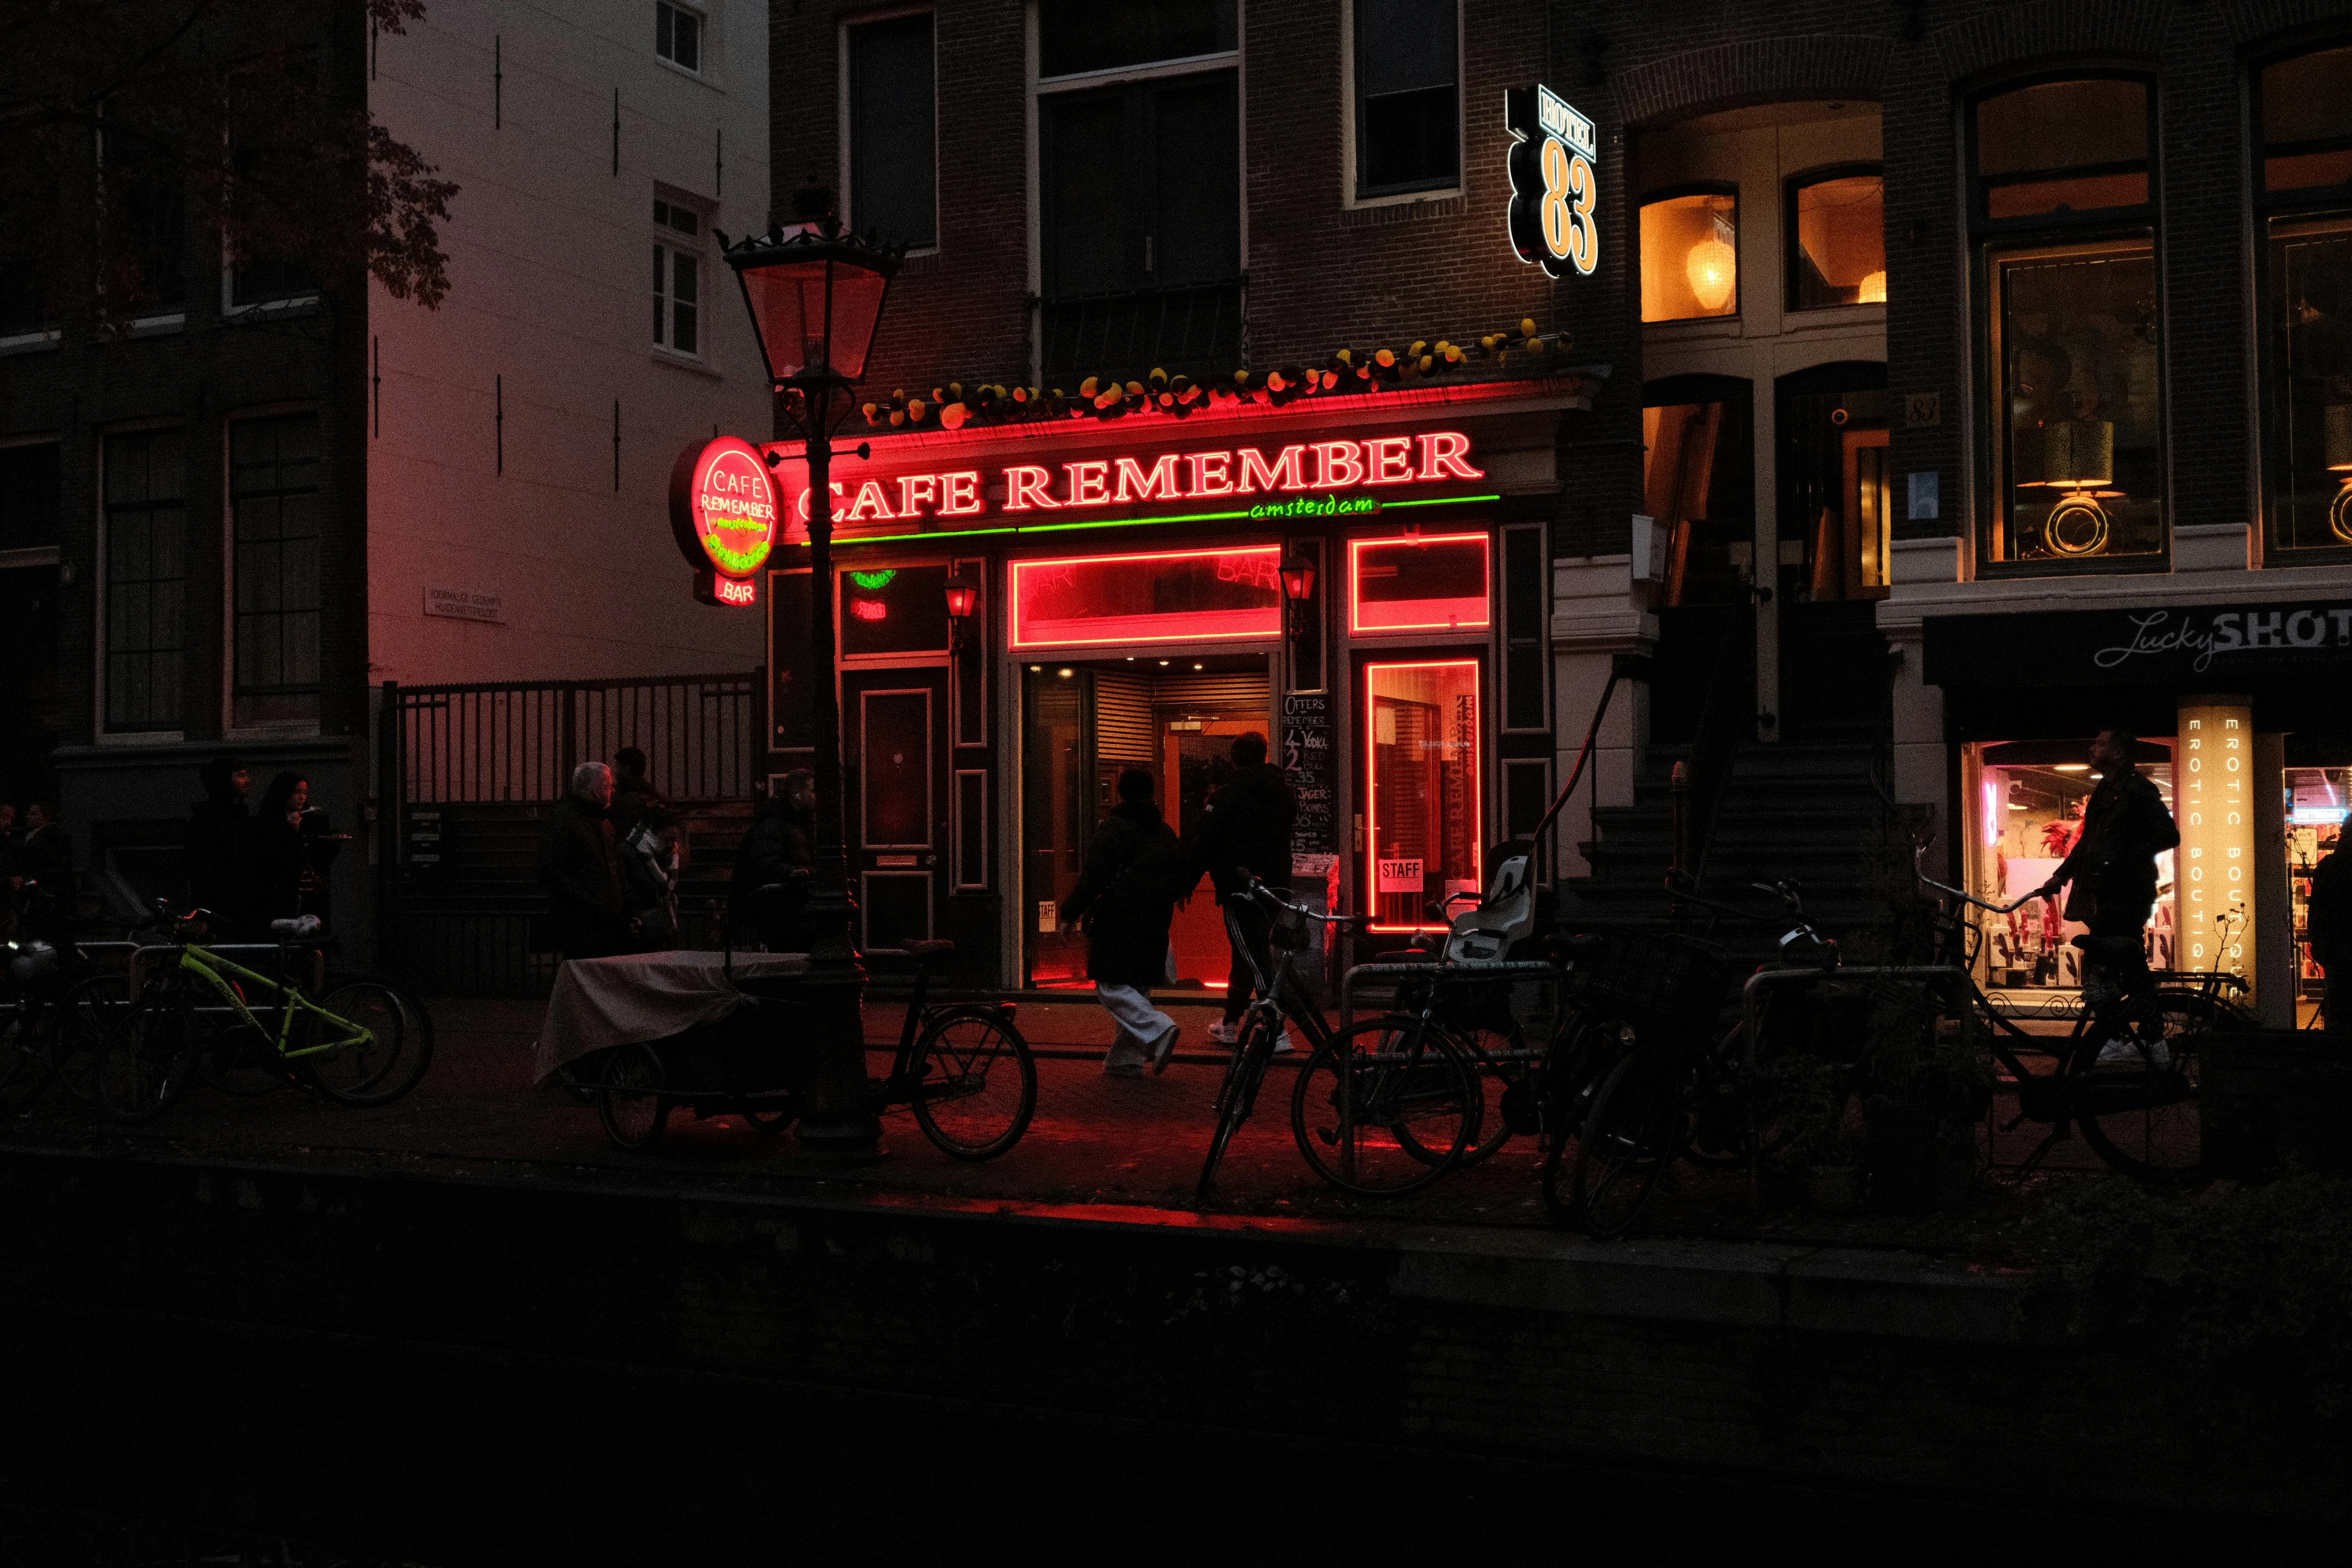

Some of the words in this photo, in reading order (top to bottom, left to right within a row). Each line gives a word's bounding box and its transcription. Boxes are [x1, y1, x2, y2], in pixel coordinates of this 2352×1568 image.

[1542, 91, 1593, 152] HOTEL
[1541, 136, 1598, 275] 83
[714, 470, 762, 498] CAFE
[1003, 432, 1485, 509] REMEMBER
[702, 494, 775, 520] REMEMBER
[1250, 494, 1373, 518] amsterdam
[720, 582, 754, 602] BAR
[2094, 610, 2214, 672] Lucky
[1285, 696, 1325, 714] OFFERS
[1285, 729, 1301, 748] 4
[1301, 730, 1328, 750] VODKA
[2190, 720, 2202, 825] EROTIC
[2226, 719, 2240, 825] EROTIC
[1299, 800, 1329, 814] BOMBS
[1383, 863, 1420, 877] STAFF
[2191, 848, 2204, 990] BOUTIQU
